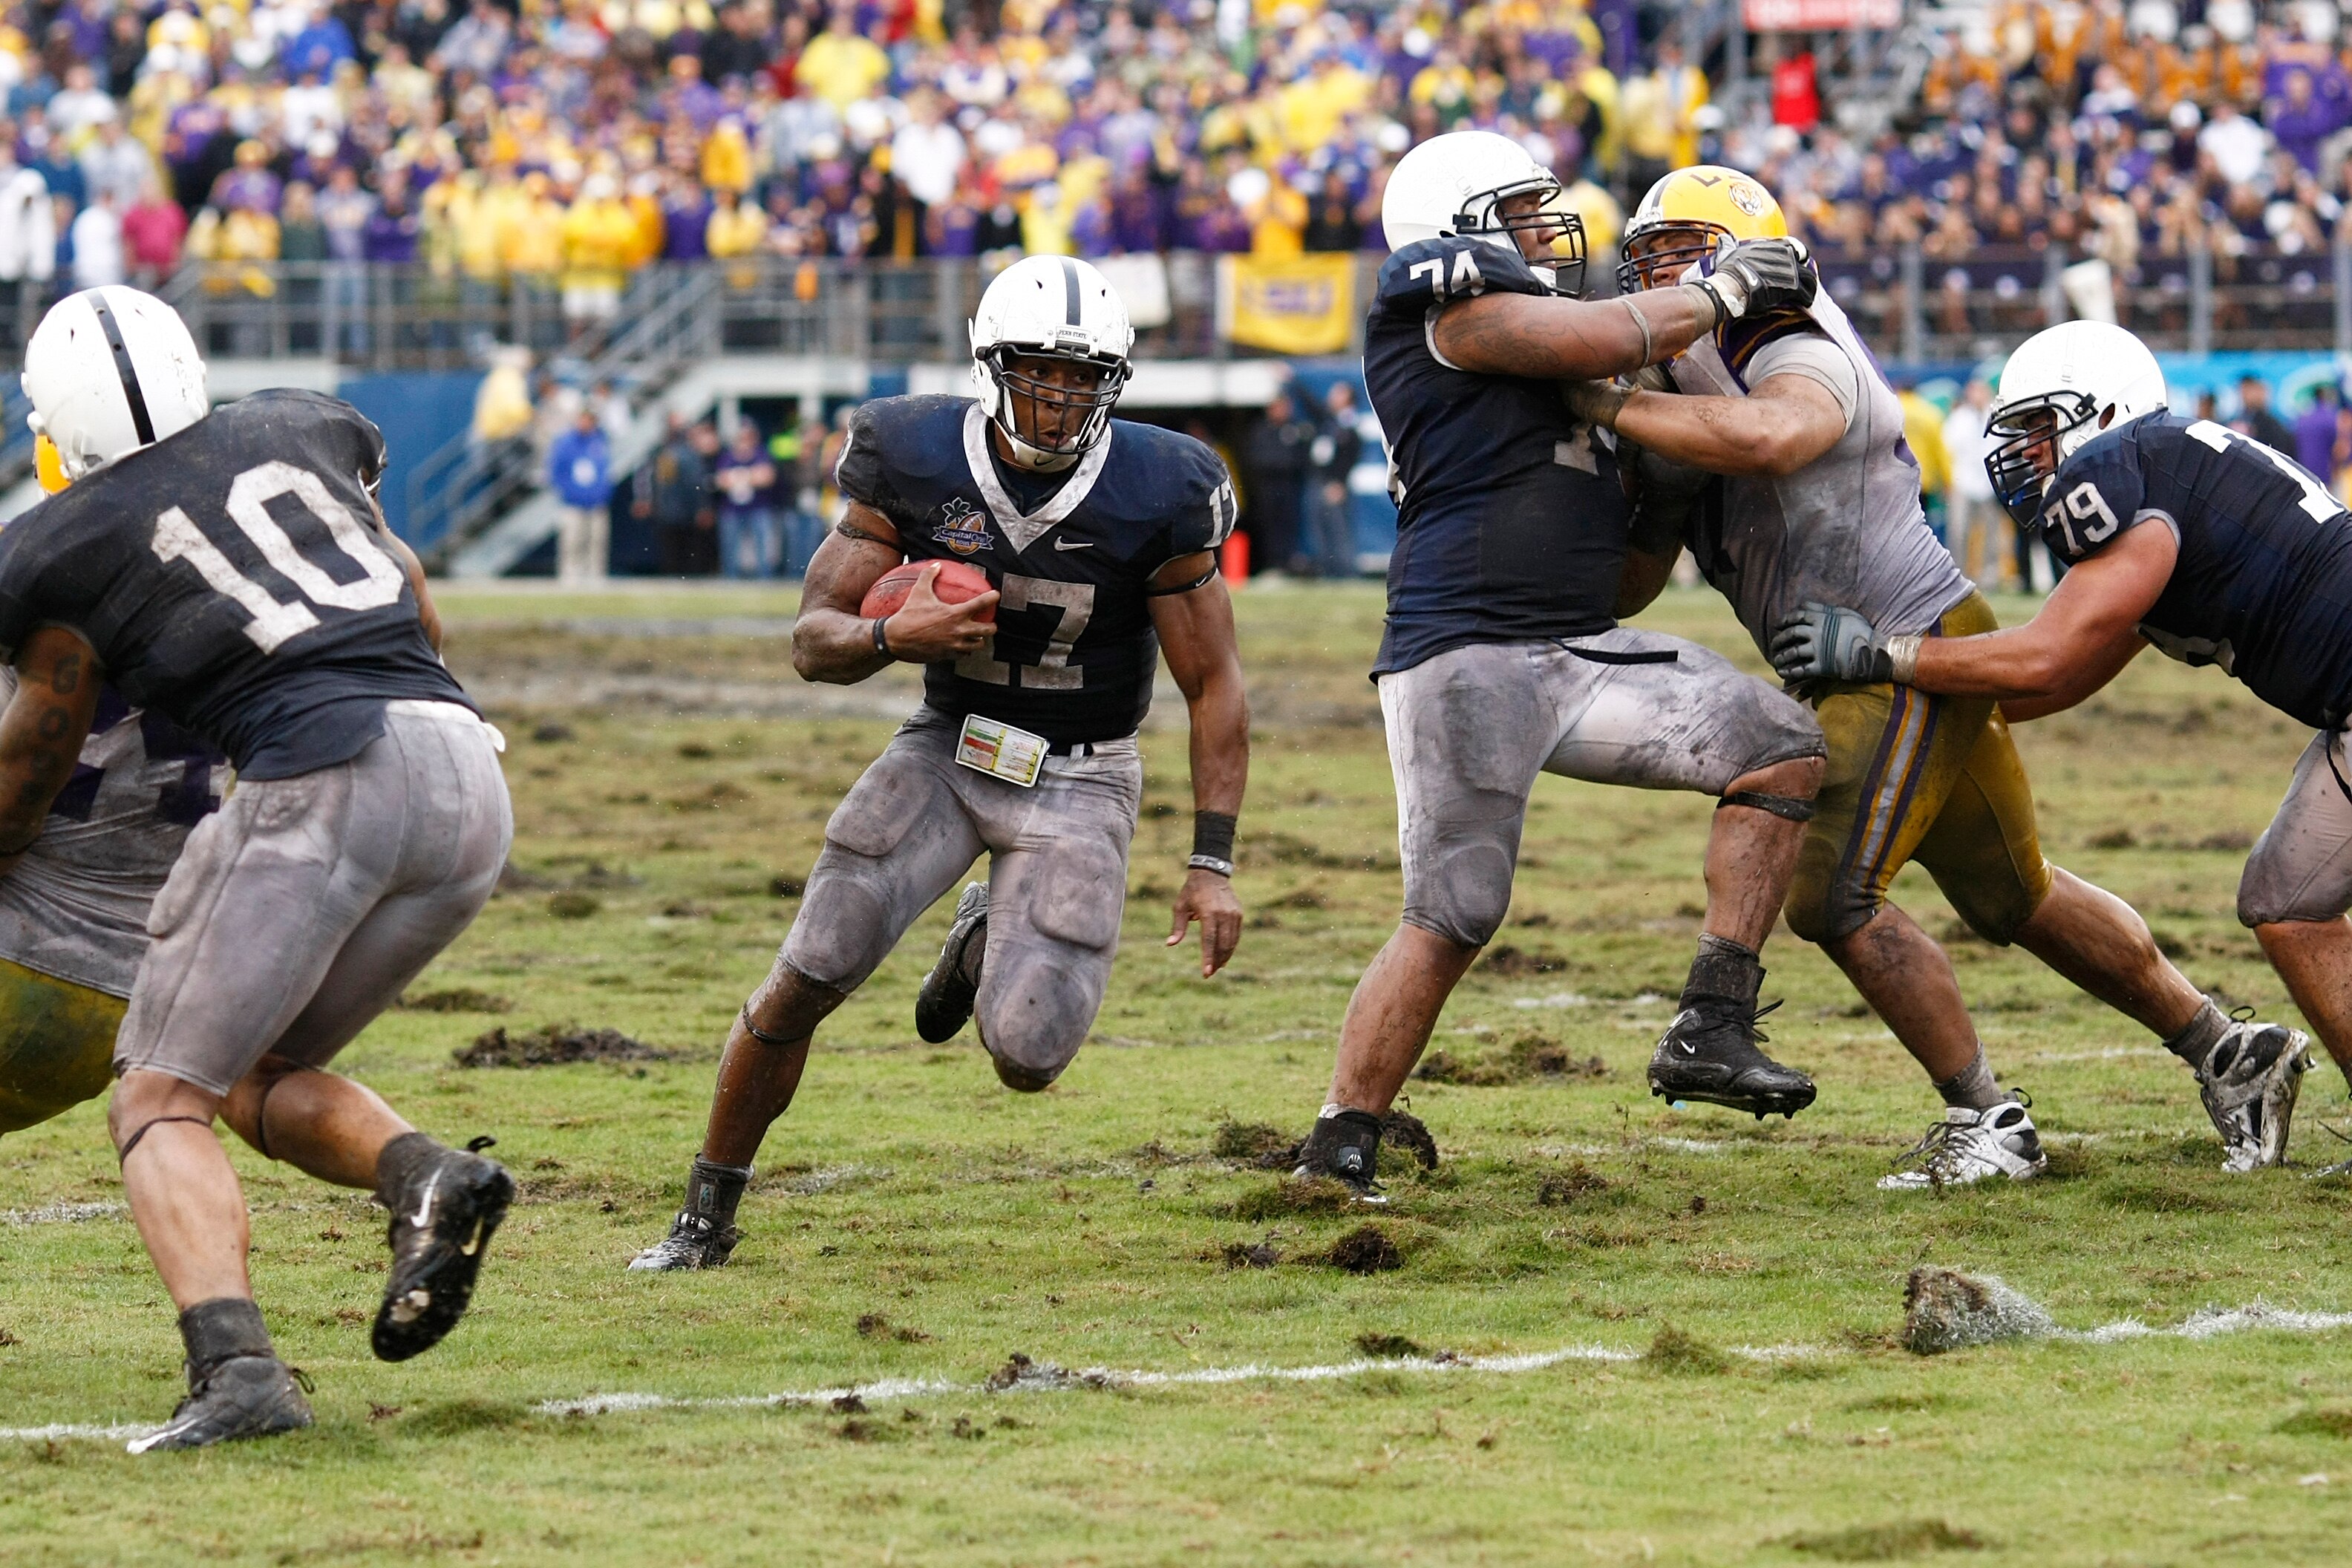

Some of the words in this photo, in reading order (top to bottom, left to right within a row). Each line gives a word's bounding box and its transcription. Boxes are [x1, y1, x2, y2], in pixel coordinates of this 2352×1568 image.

[1409, 249, 1485, 303] 74
[1203, 475, 1238, 548] 17
[2044, 481, 2119, 556] 79
[151, 460, 405, 656] 10
